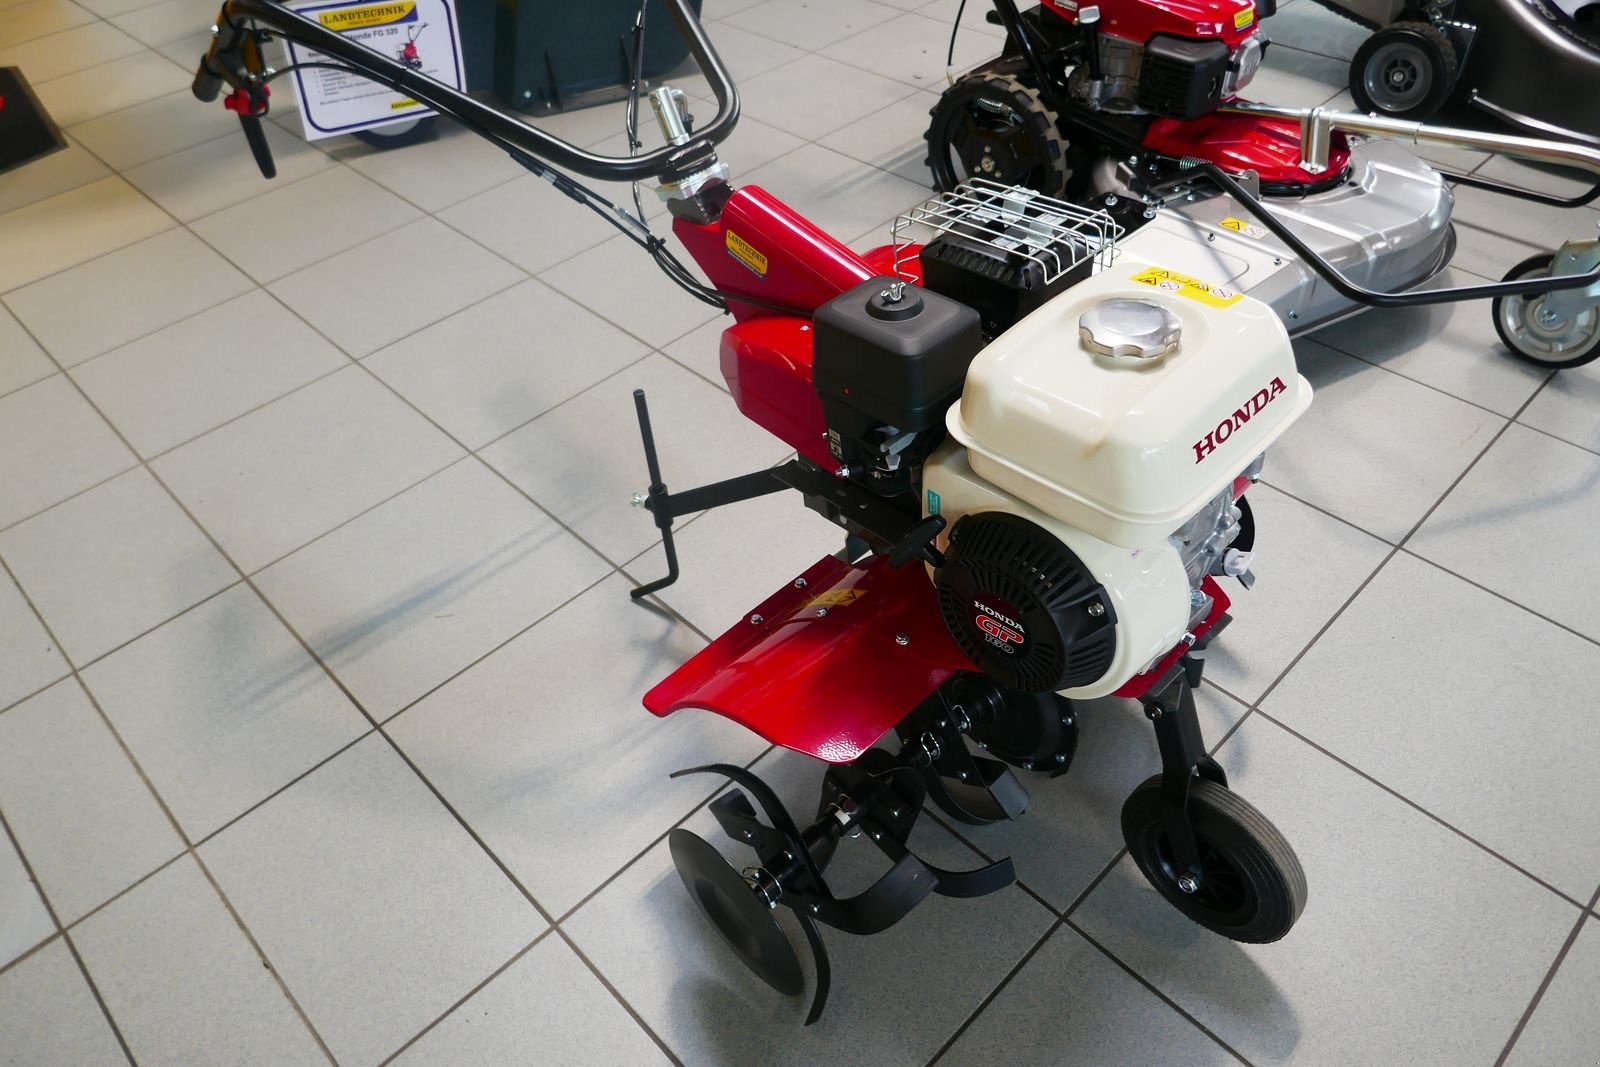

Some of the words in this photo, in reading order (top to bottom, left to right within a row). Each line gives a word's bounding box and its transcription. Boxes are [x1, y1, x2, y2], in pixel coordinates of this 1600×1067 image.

[323, 5, 406, 24] LANDTECHNIK
[385, 28, 399, 36] 320
[1192, 376, 1287, 465] HONDA
[974, 600, 1026, 634] HONDA
[975, 614, 1025, 644] GP
[984, 633, 1015, 654] 160
